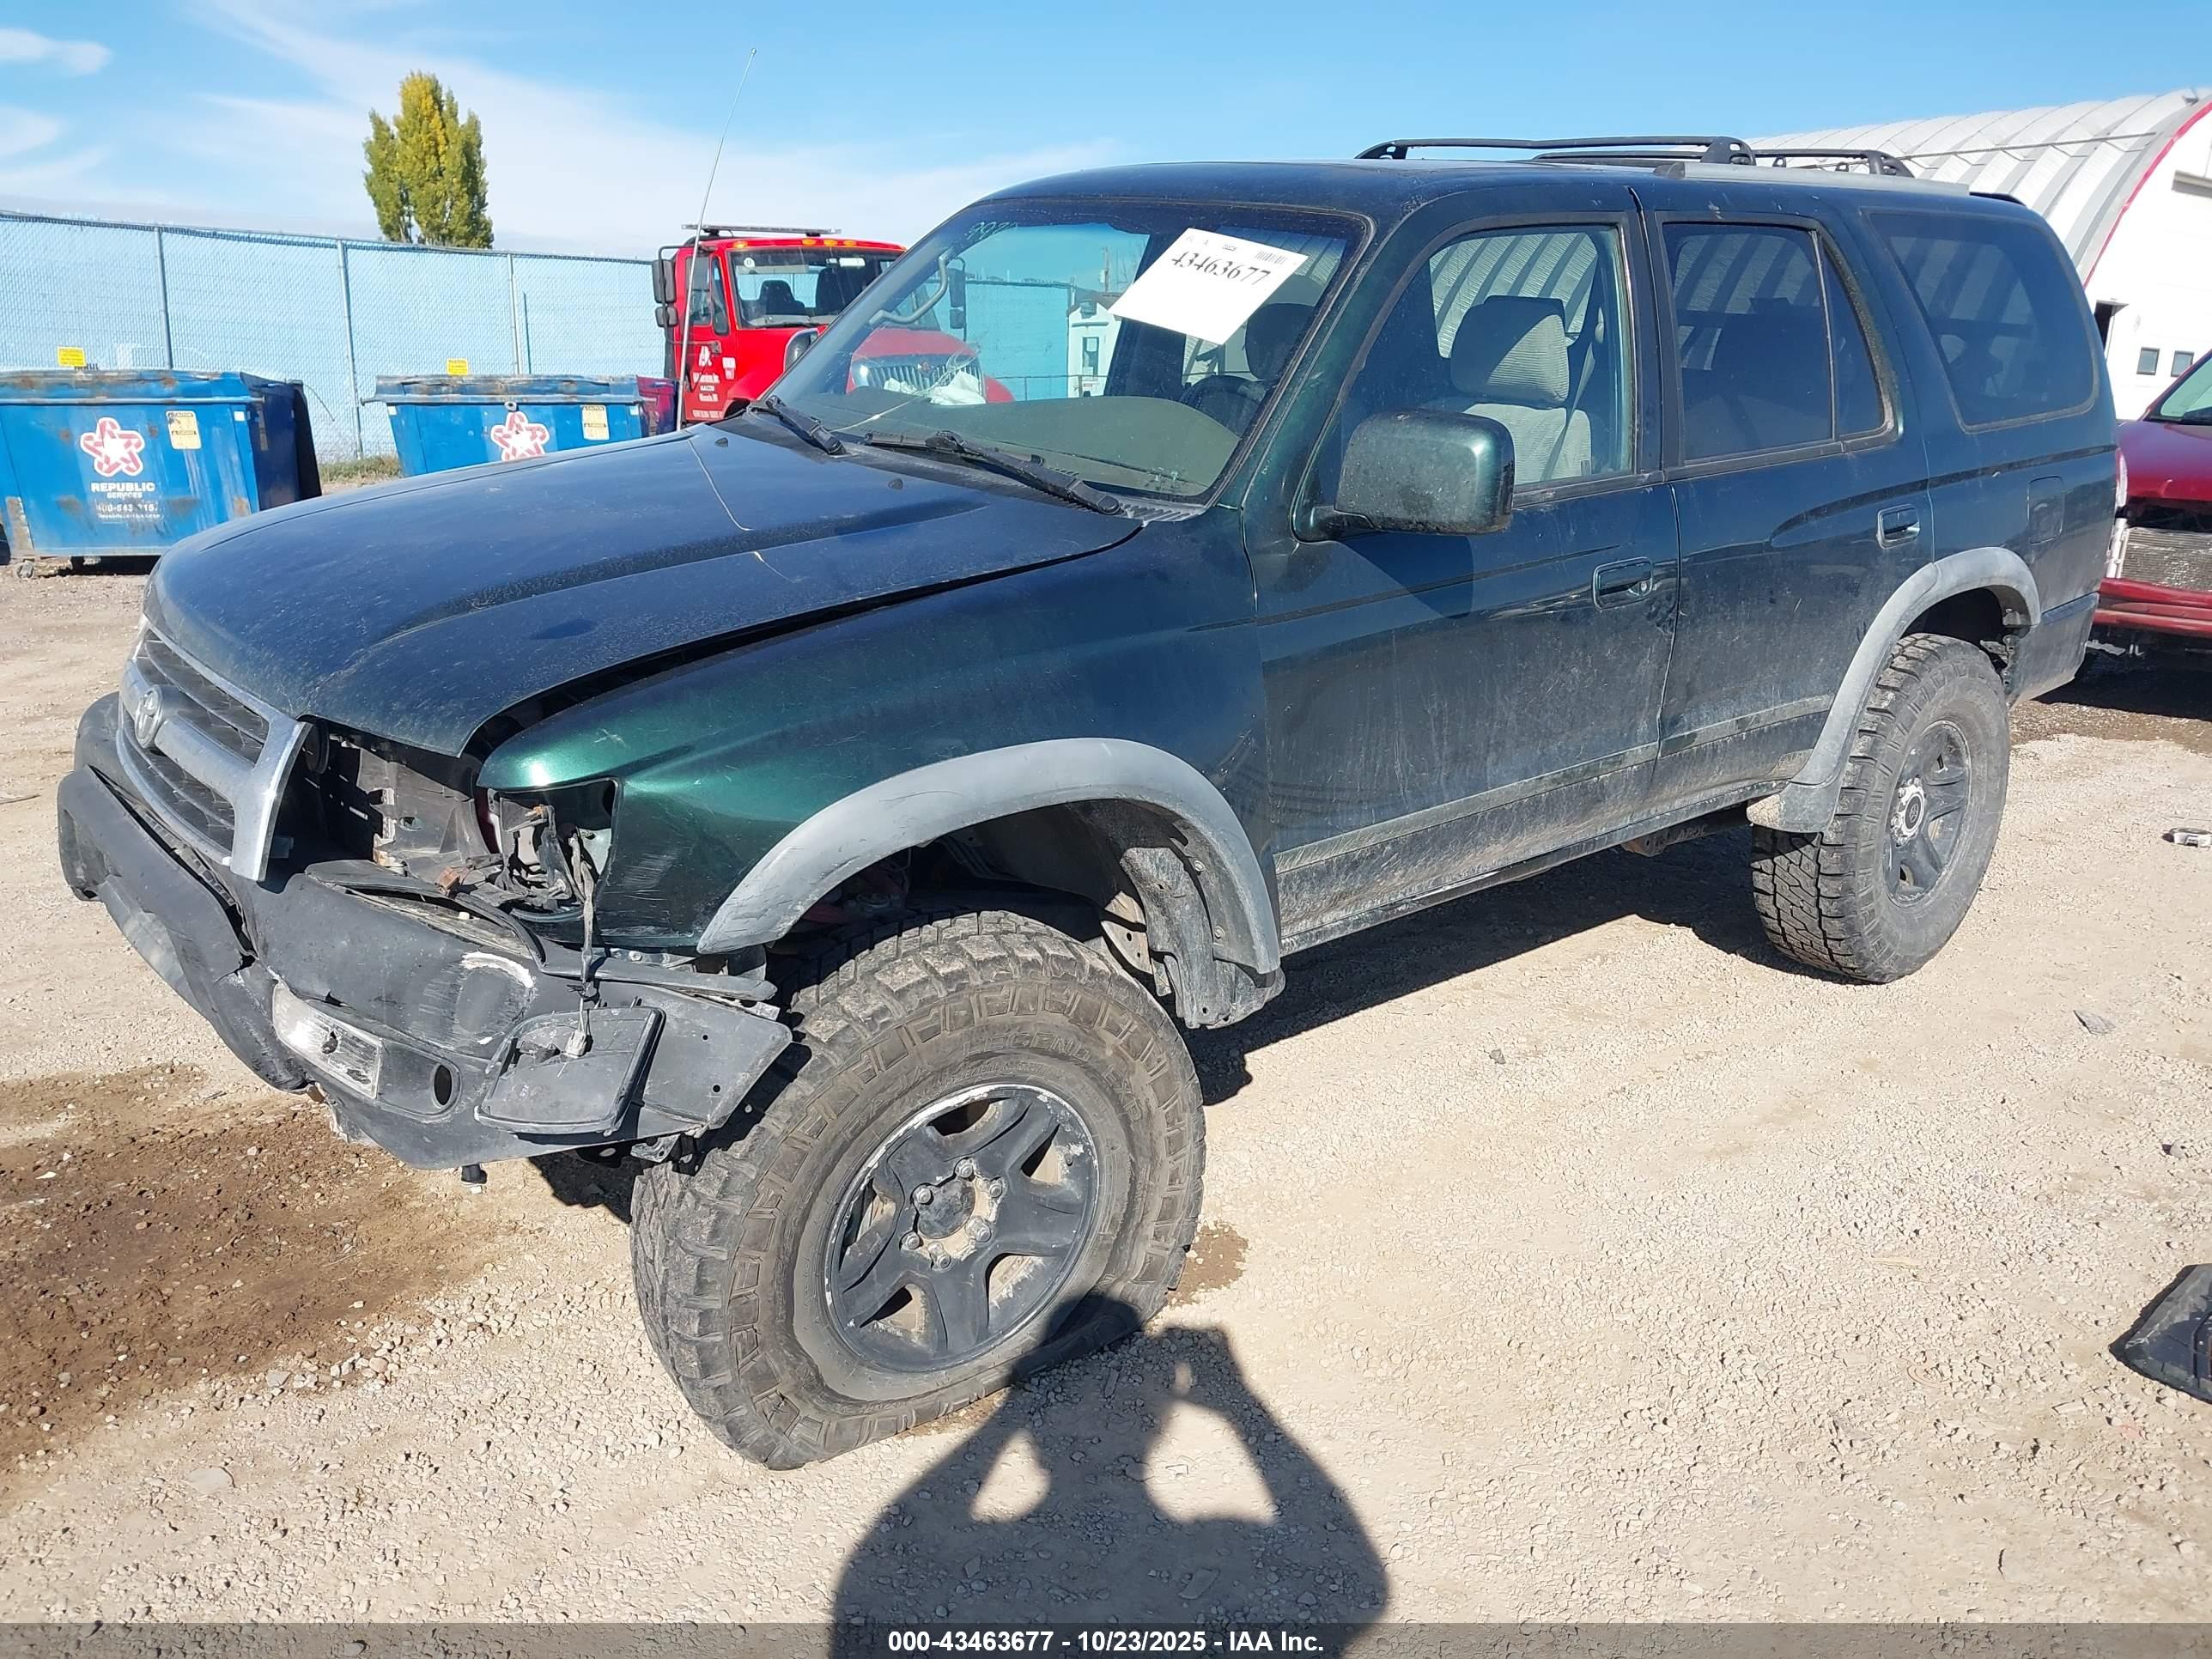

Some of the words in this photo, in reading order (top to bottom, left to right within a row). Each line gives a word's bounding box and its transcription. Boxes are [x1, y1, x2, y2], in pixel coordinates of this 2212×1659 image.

[1171, 251, 1272, 285] 43463677
[90, 482, 155, 493] REPUBLIC
[963, 1030, 1091, 1062] LEGEND
